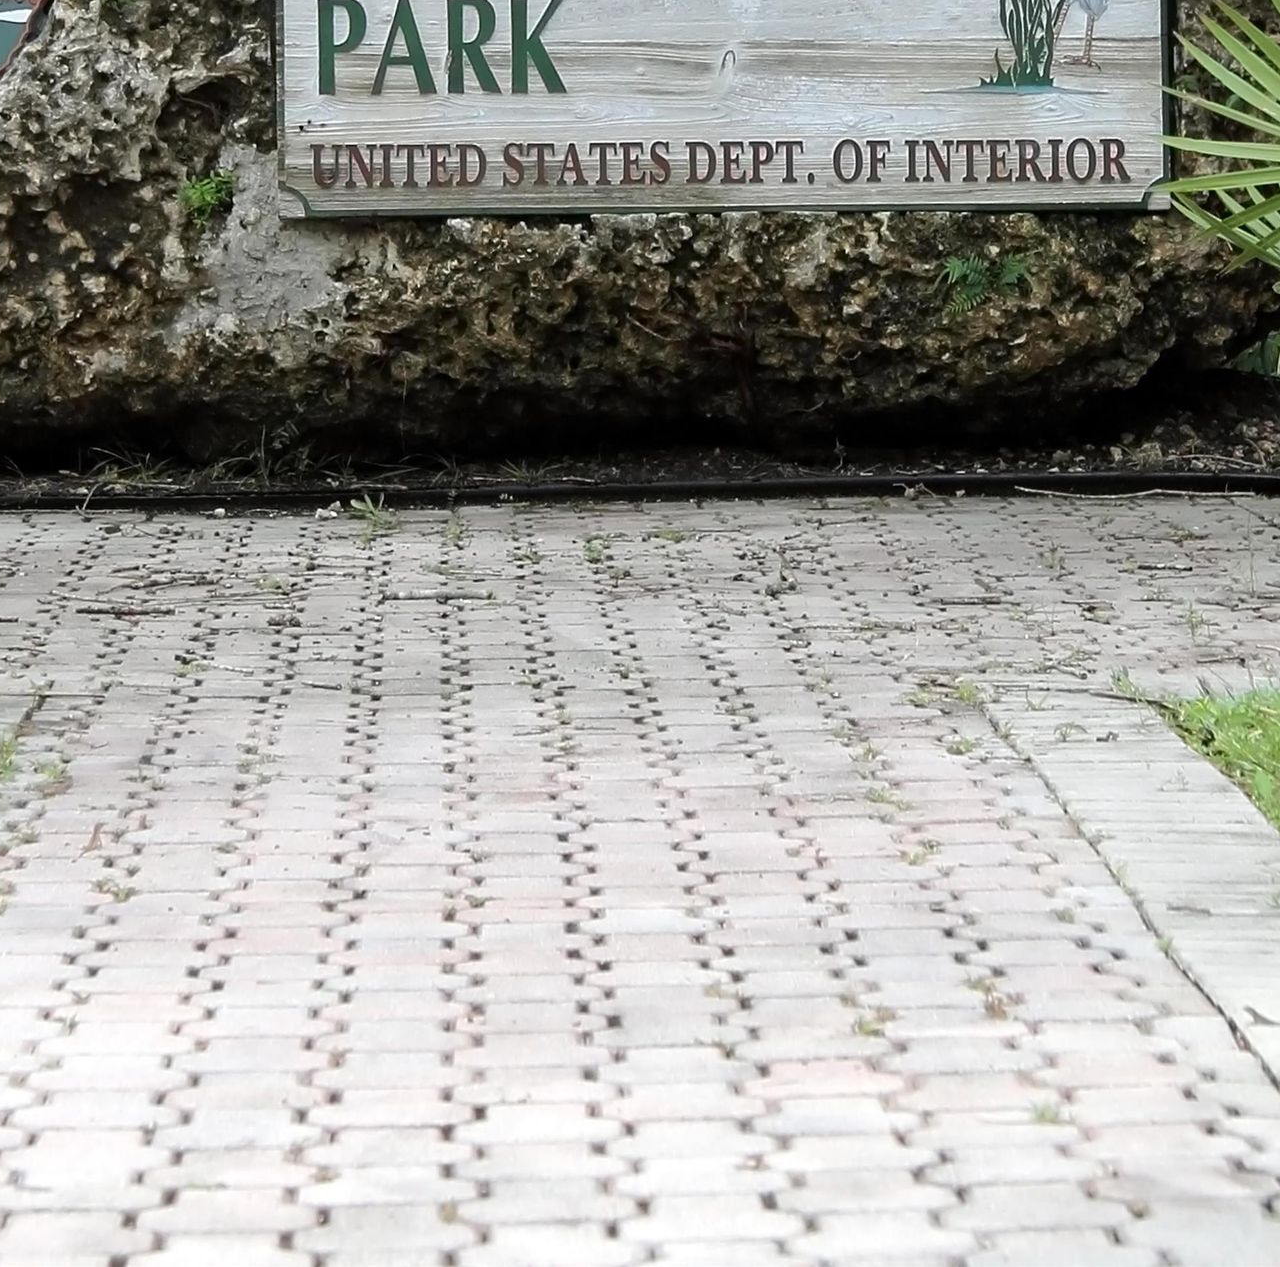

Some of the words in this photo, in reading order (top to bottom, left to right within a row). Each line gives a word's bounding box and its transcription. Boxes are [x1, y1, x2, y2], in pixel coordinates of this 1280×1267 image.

[311, 142, 488, 189] UNITED
[502, 140, 672, 187] STATES
[685, 139, 816, 185] DEPT.
[833, 138, 892, 183] OF
[904, 136, 1131, 184] INTERIOR
